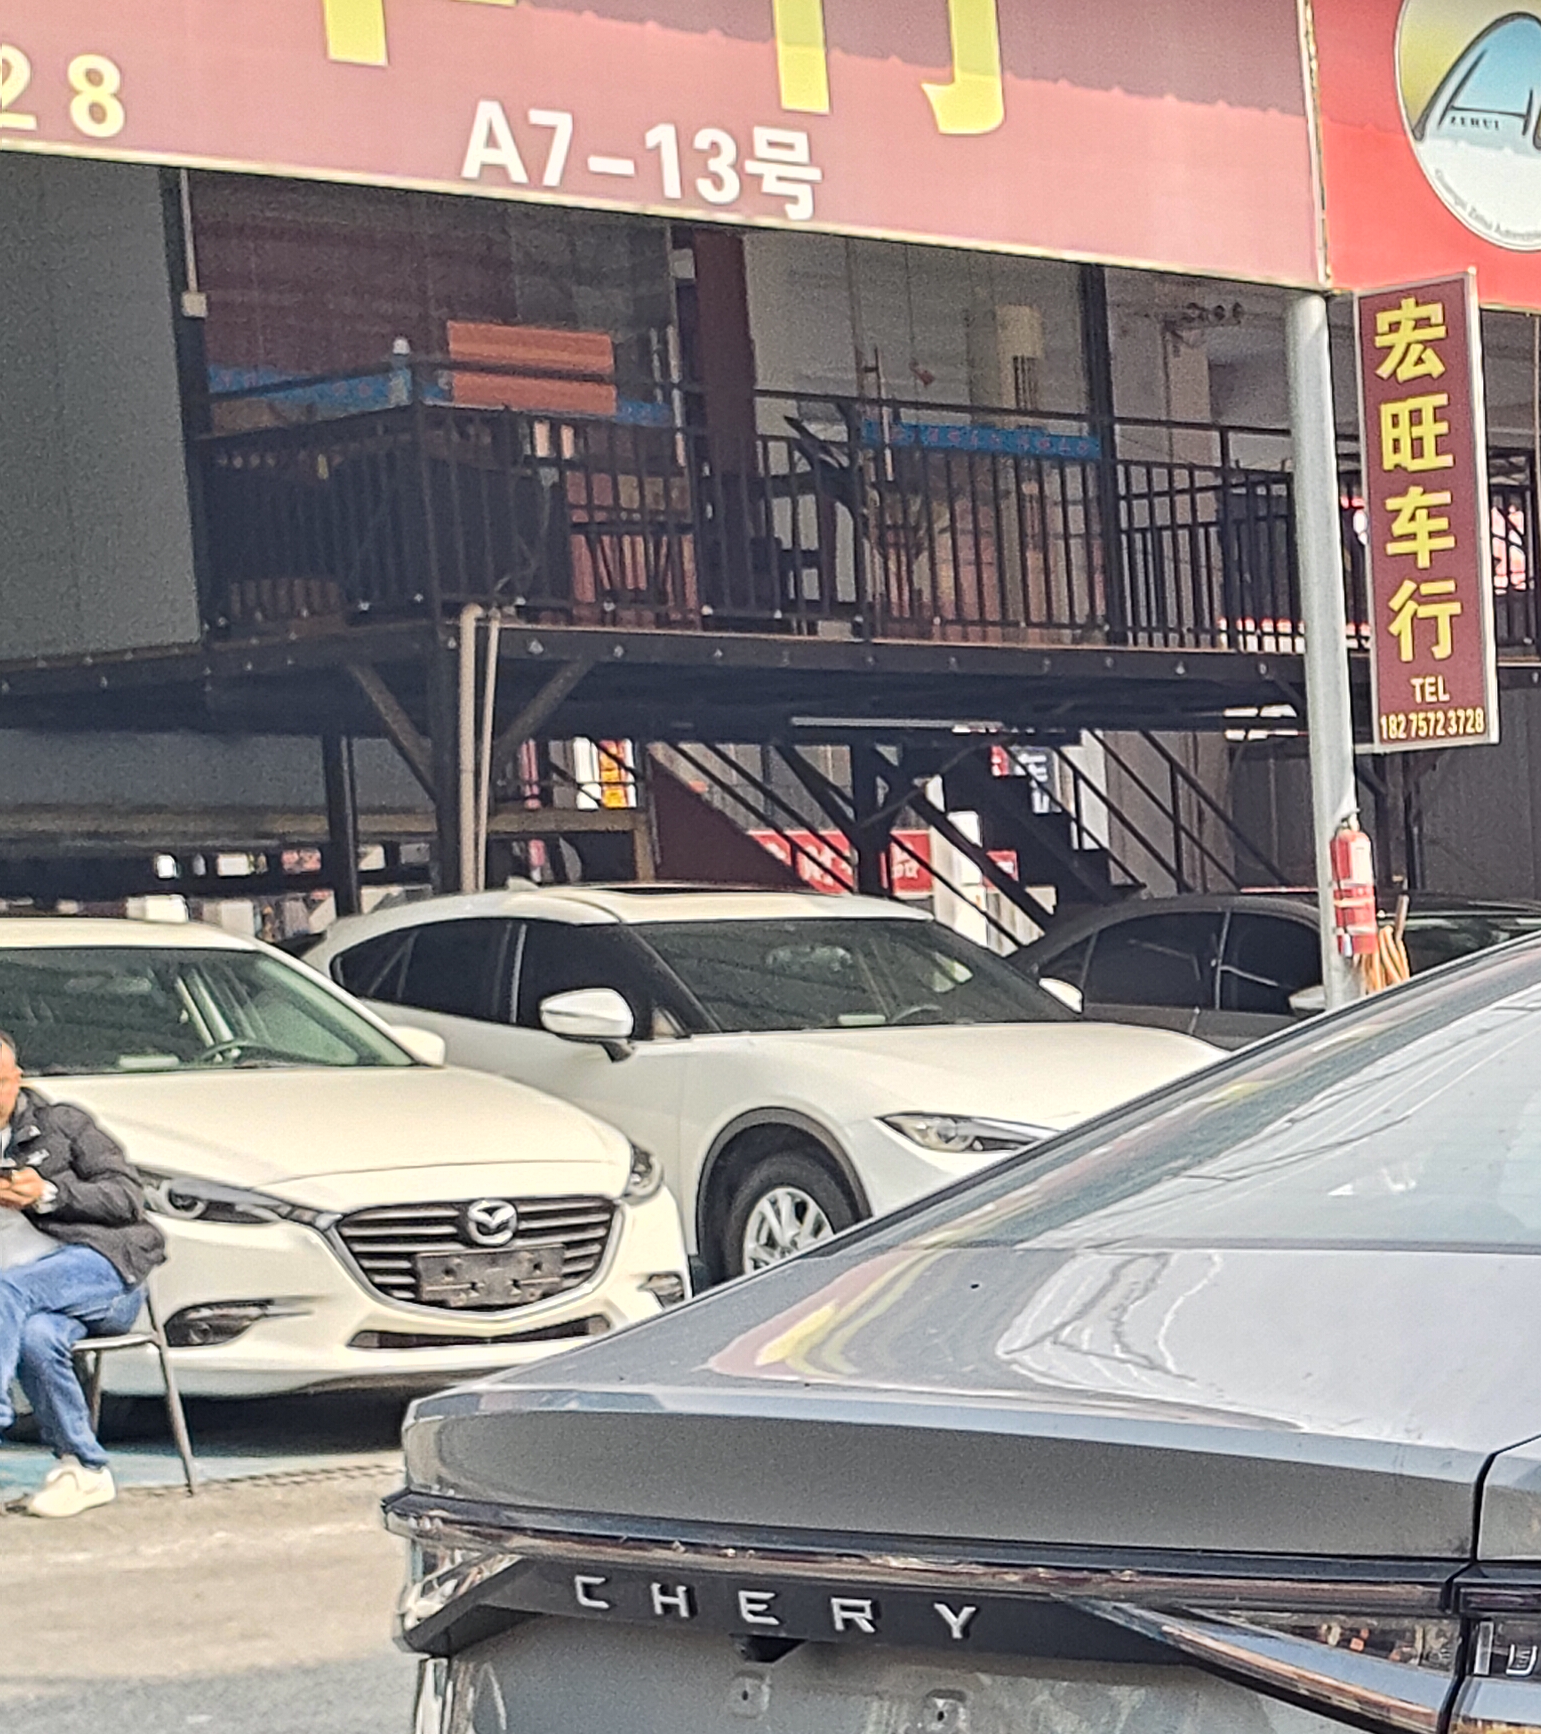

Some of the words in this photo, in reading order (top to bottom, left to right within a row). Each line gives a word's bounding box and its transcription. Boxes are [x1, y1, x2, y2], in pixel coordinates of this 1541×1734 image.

[460, 99, 823, 221] A7-13号
[1374, 298, 1462, 662] 宏旺车行
[1410, 674, 1450, 704] TEL
[573, 1575, 977, 1640] CHERY
